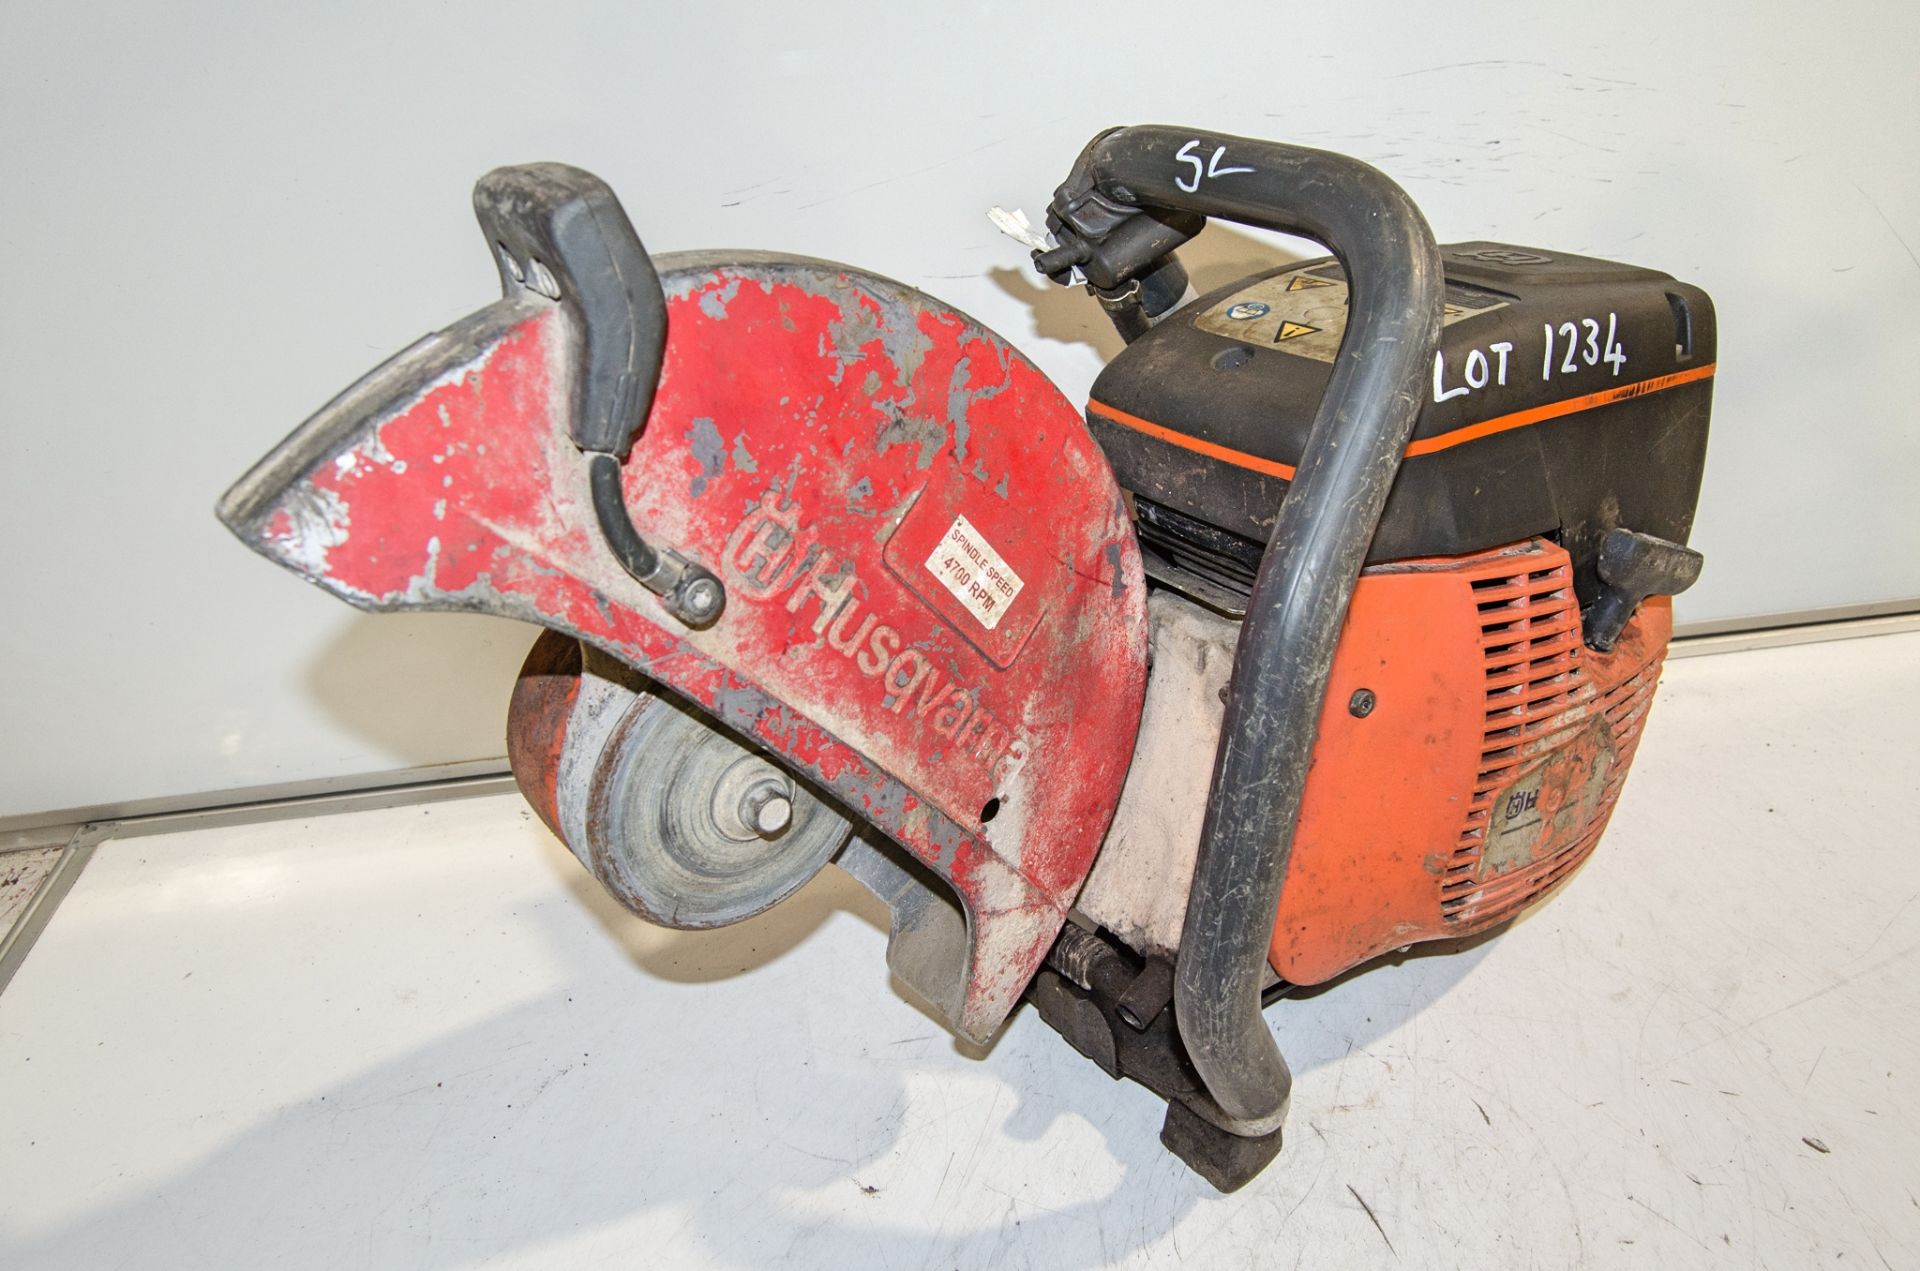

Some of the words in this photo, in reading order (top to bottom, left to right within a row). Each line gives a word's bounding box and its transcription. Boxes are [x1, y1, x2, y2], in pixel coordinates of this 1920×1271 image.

[1175, 140, 1257, 193] SL
[1433, 341, 1513, 403] LOT
[1543, 313, 1627, 381] 1234
[944, 557, 971, 586] 4700
[968, 581, 996, 612] RPM
[952, 529, 988, 569] SPINDLE
[987, 567, 1014, 598] SPEED
